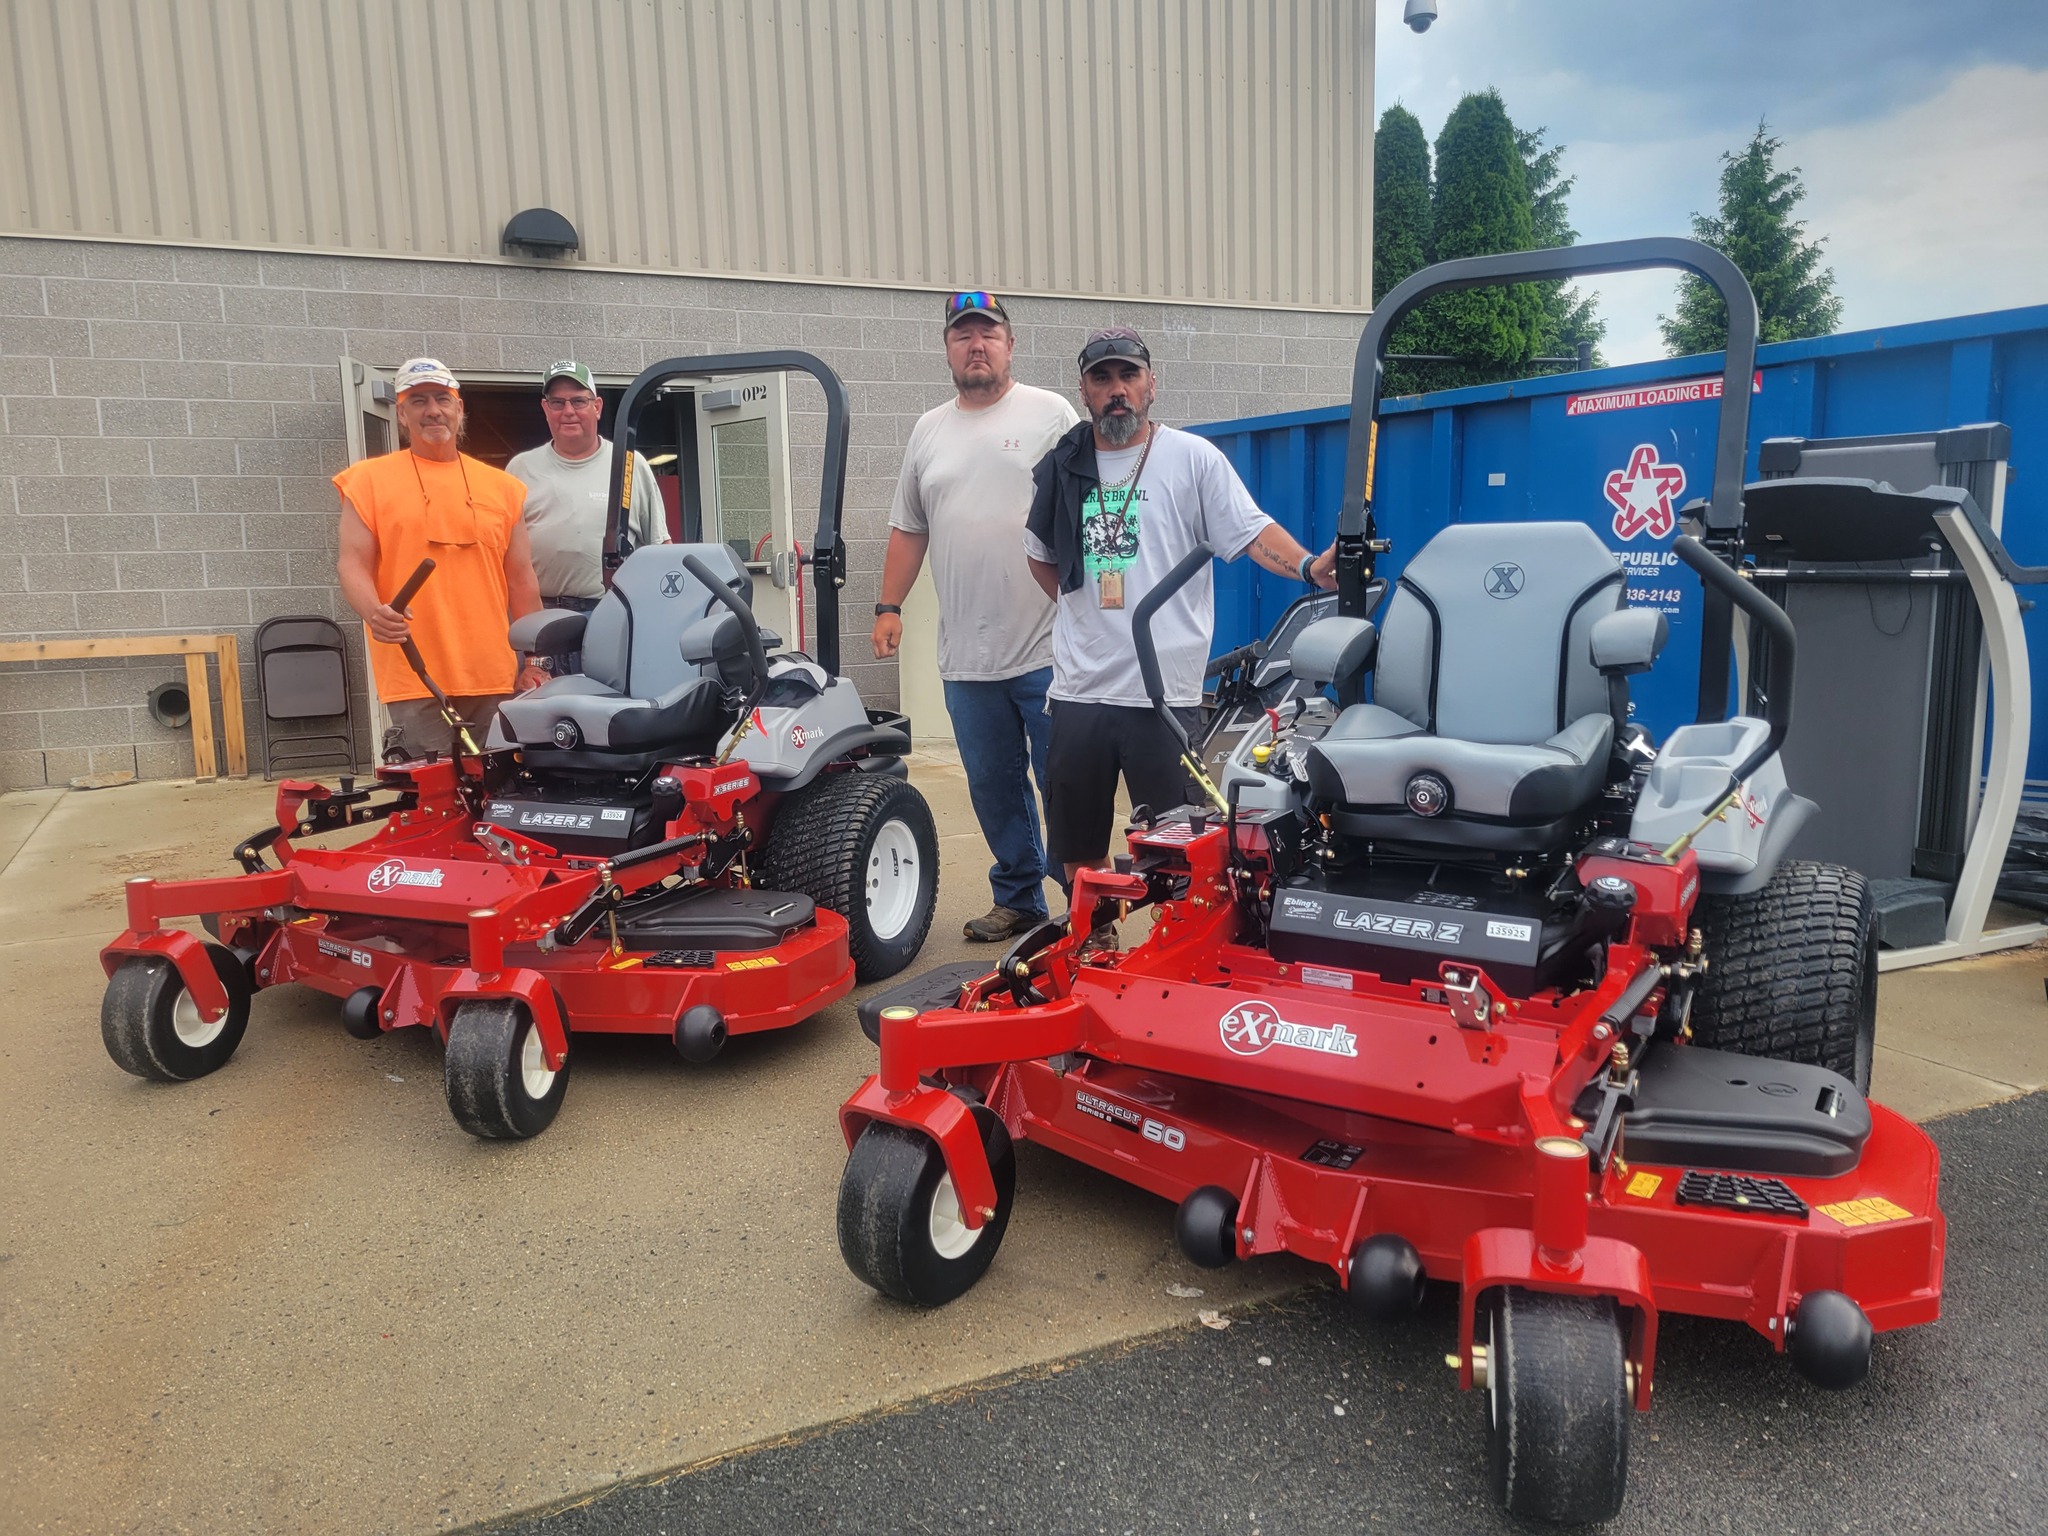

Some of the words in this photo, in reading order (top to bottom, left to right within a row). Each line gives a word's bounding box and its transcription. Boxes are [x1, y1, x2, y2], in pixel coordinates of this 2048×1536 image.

[742, 384, 767, 402] OP2
[1577, 395, 1636, 414] MAXIMUM
[1639, 386, 1701, 406] LOADING
[1612, 552, 1679, 566] PUBLIC
[1626, 567, 1660, 577] RVICES
[713, 777, 750, 797] X-SERIES
[520, 812, 578, 828] LAZER
[576, 815, 594, 829] Z
[1283, 897, 1318, 908] Ebling's
[1333, 909, 1435, 941] LAZER
[1434, 921, 1464, 944] Z
[1489, 925, 1527, 939] 135925
[351, 949, 373, 969] 60
[1076, 1089, 1142, 1125] ULTRACUT
[1076, 1103, 1105, 1120] SERIES
[1142, 1117, 1186, 1152] 60
